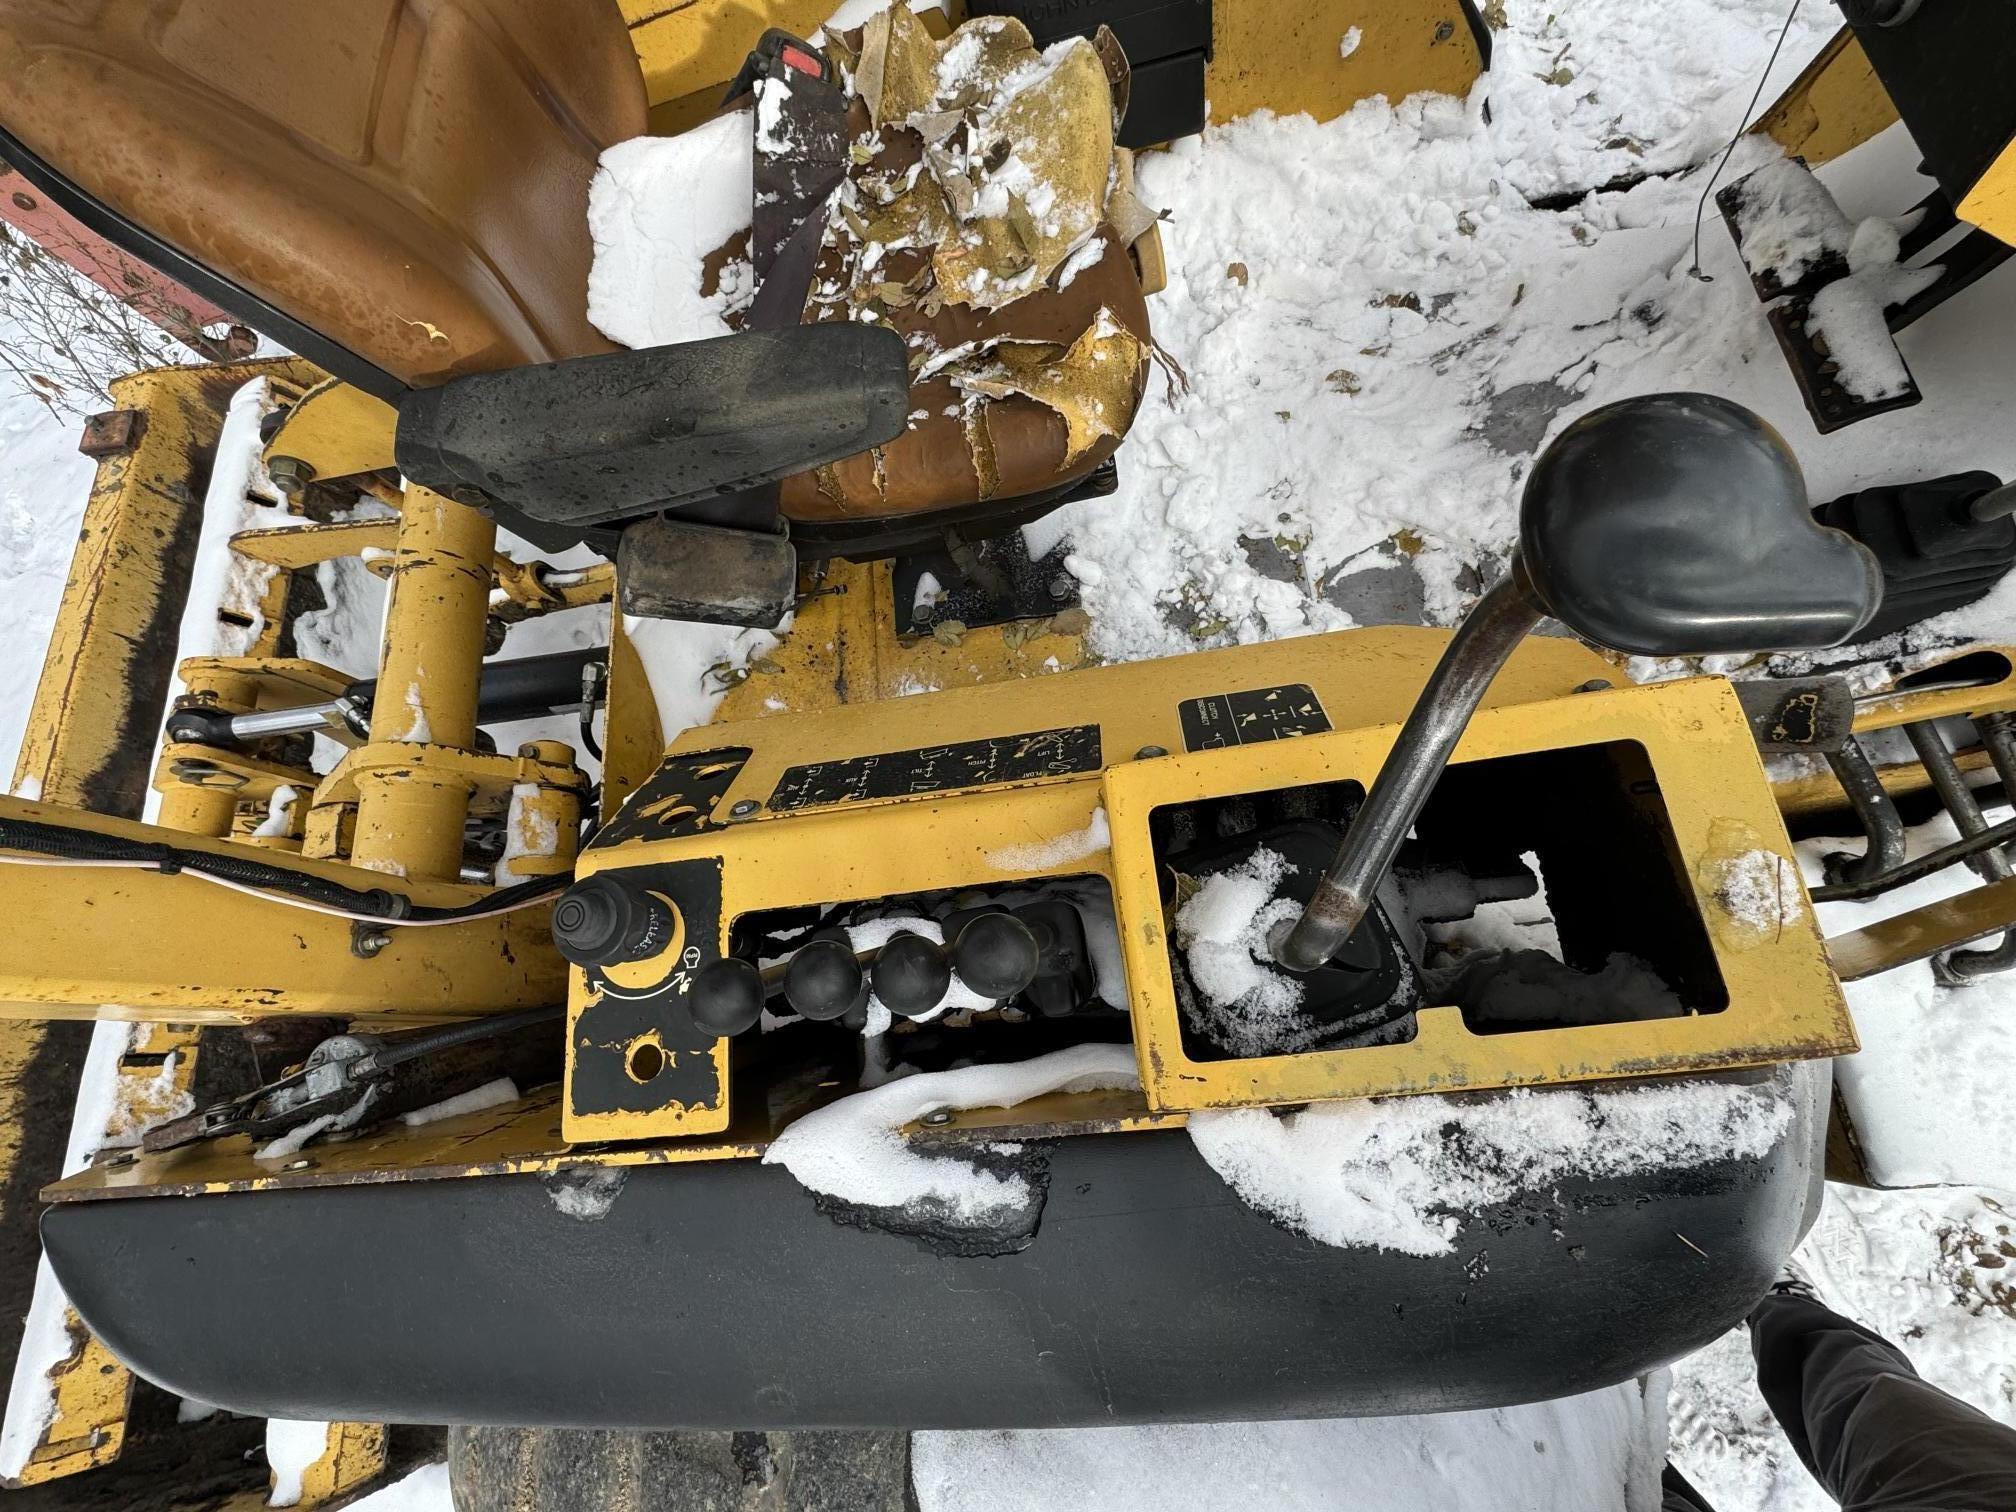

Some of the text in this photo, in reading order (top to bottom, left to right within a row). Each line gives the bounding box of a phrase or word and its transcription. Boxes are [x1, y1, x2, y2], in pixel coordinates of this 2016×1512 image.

[1197, 699, 1210, 726] DISCONNECT
[1208, 702, 1219, 720] CLUTCH
[1022, 770, 1043, 779] FLOAT
